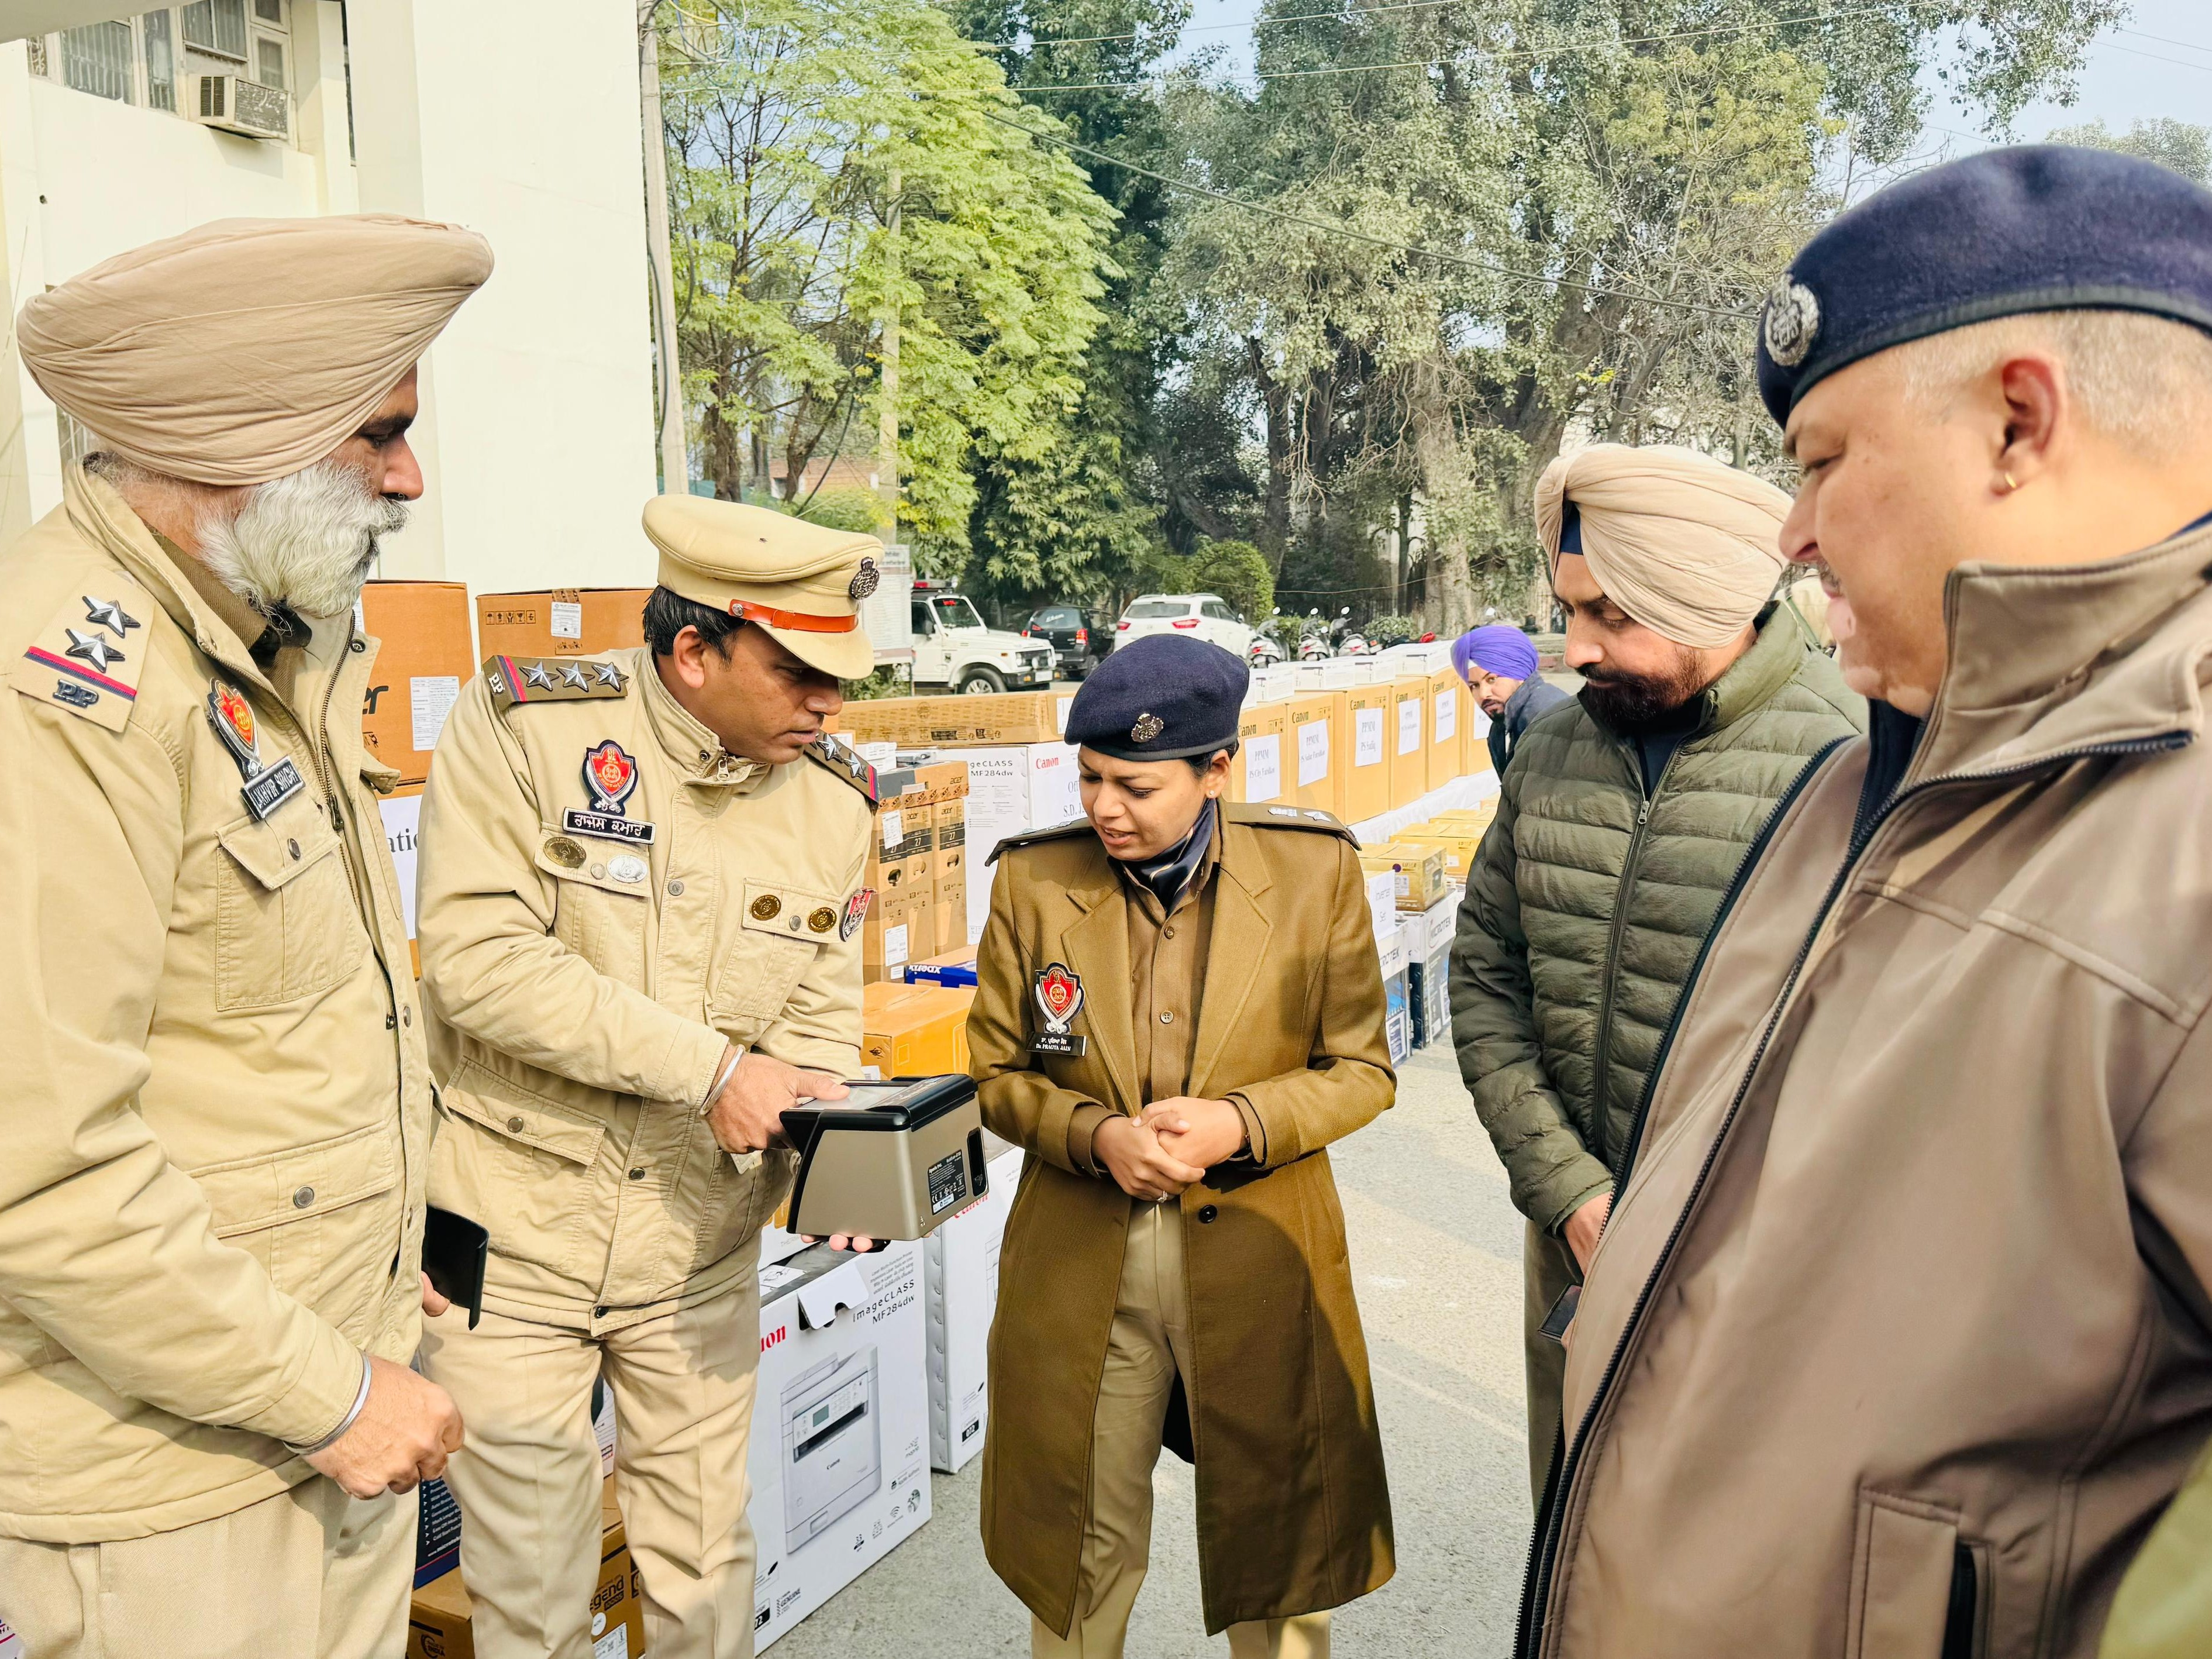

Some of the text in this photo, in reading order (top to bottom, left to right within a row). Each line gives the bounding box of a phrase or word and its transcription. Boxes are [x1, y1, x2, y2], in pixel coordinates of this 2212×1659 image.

[1292, 711, 1309, 724] Canon
[1238, 724, 1256, 737] Canon
[1036, 757, 1059, 769] Canon
[274, 765, 298, 790] SINGH
[853, 1279, 914, 1323] imageCLASS
[873, 1295, 915, 1324] MF284dw
